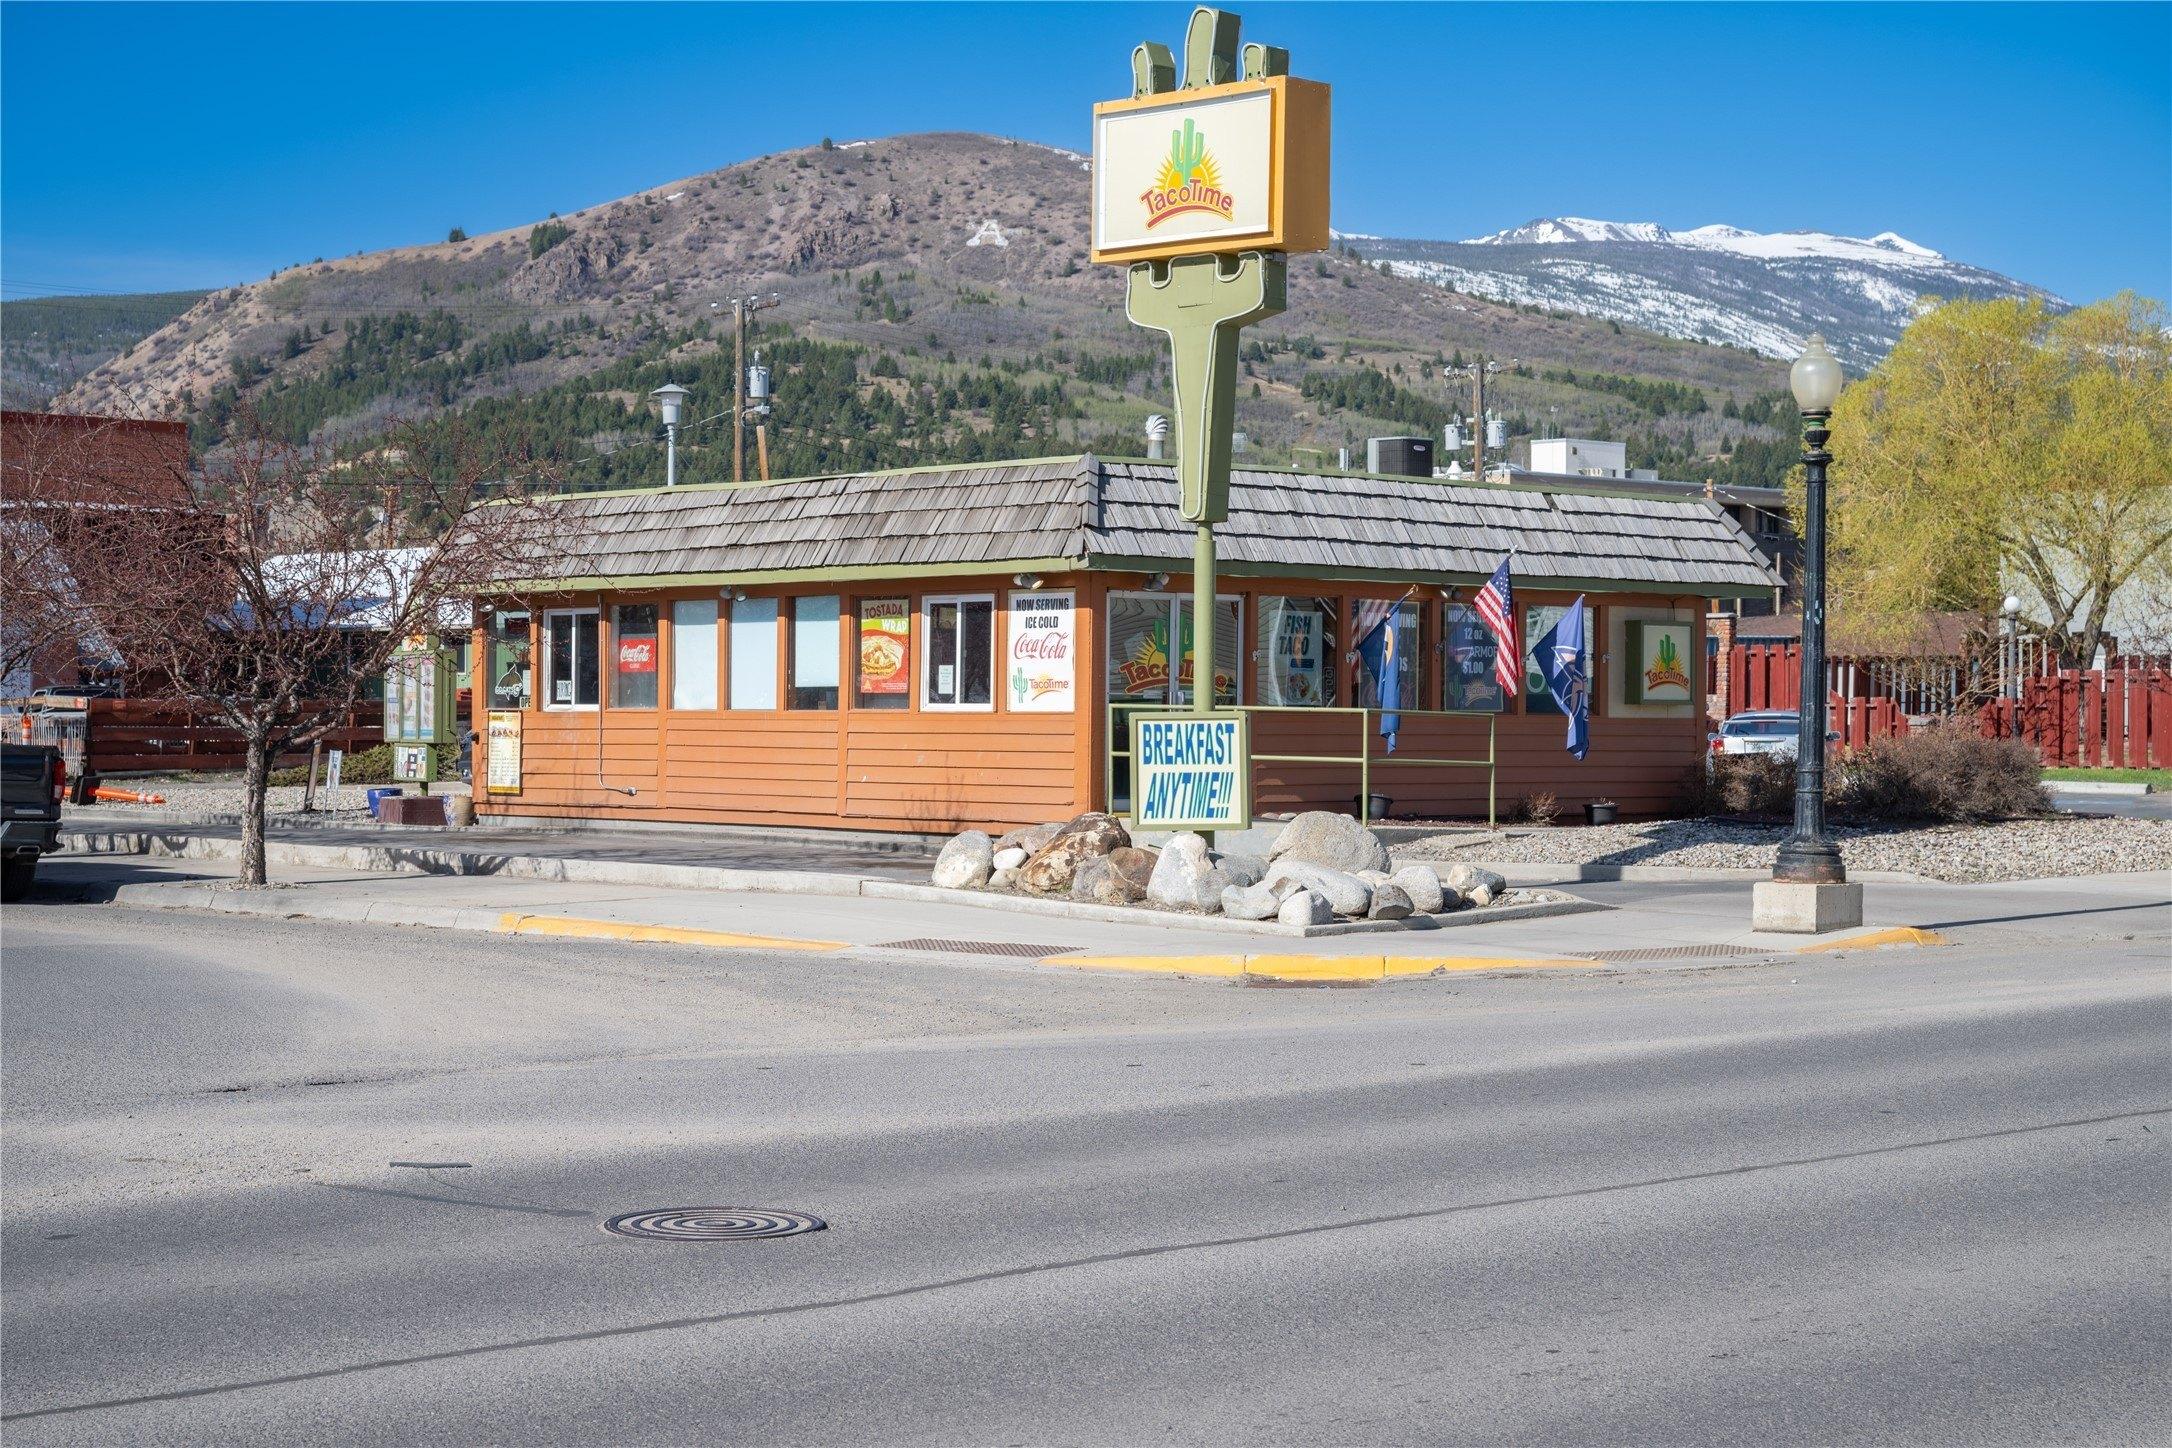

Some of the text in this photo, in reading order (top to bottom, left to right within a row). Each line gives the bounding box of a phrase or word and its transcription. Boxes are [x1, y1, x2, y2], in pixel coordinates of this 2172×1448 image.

[1140, 178, 1234, 216] TacoTime
[865, 603, 903, 619] TOSTADA
[1016, 597, 1069, 611] NOW SERVING
[882, 619, 907, 633] WRAP
[1025, 616, 1059, 629] ICE COLD
[1284, 615, 1312, 635] FISH
[1464, 627, 1473, 640] 12
[1014, 632, 1070, 660] Coca-Cola
[1029, 678, 1069, 689] TacoTime
[1645, 667, 1690, 687] TacoTime
[1142, 723, 1235, 765] BREAKFAST
[1143, 771, 1235, 819] ANYTIME!!!
